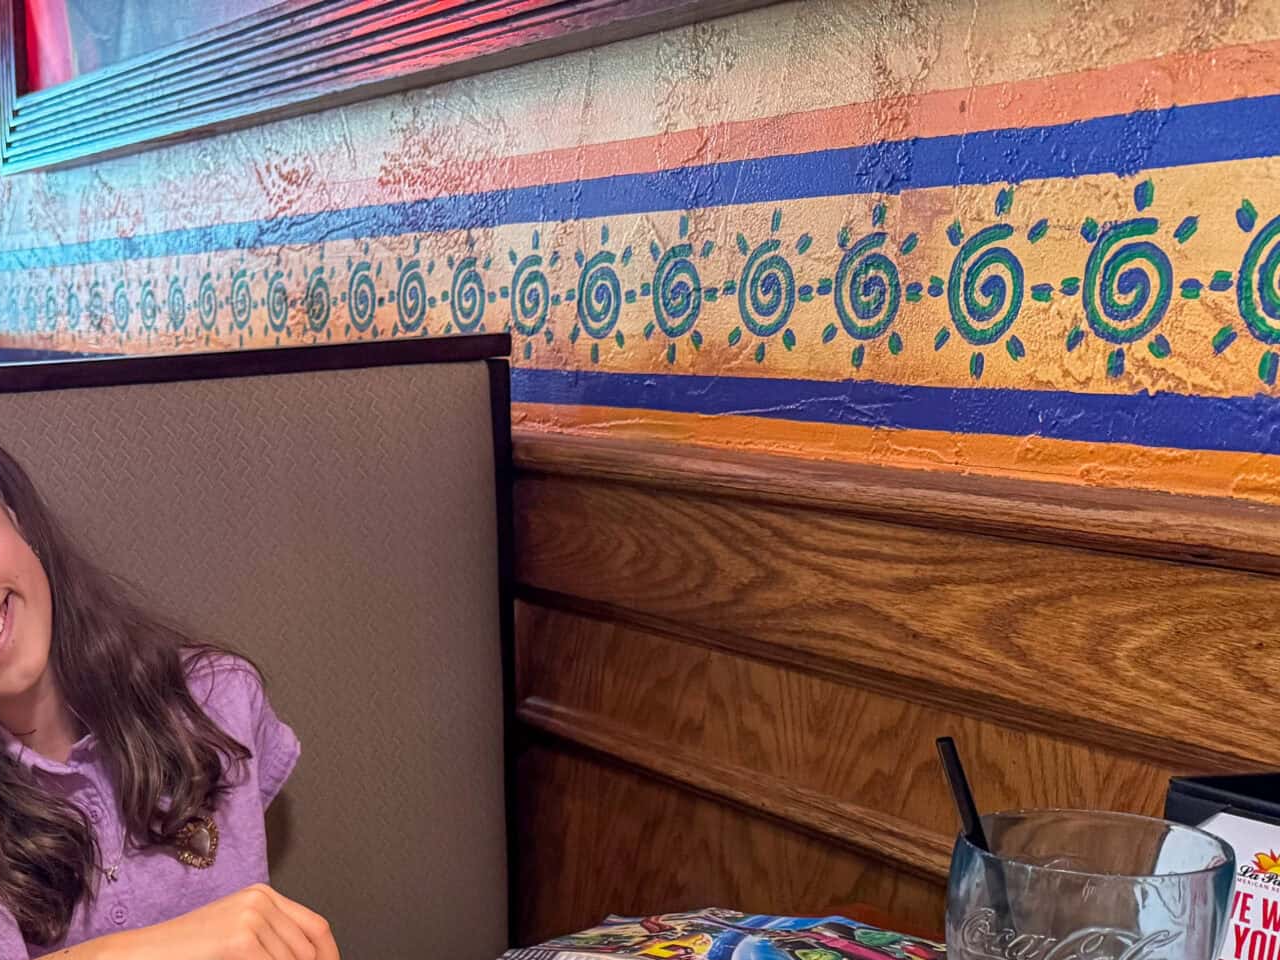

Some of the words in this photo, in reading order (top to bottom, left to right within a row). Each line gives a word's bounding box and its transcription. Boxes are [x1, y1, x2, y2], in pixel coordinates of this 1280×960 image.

[1237, 865, 1259, 880] La
[1260, 872, 1280, 887] Pa
[1230, 890, 1254, 924] E
